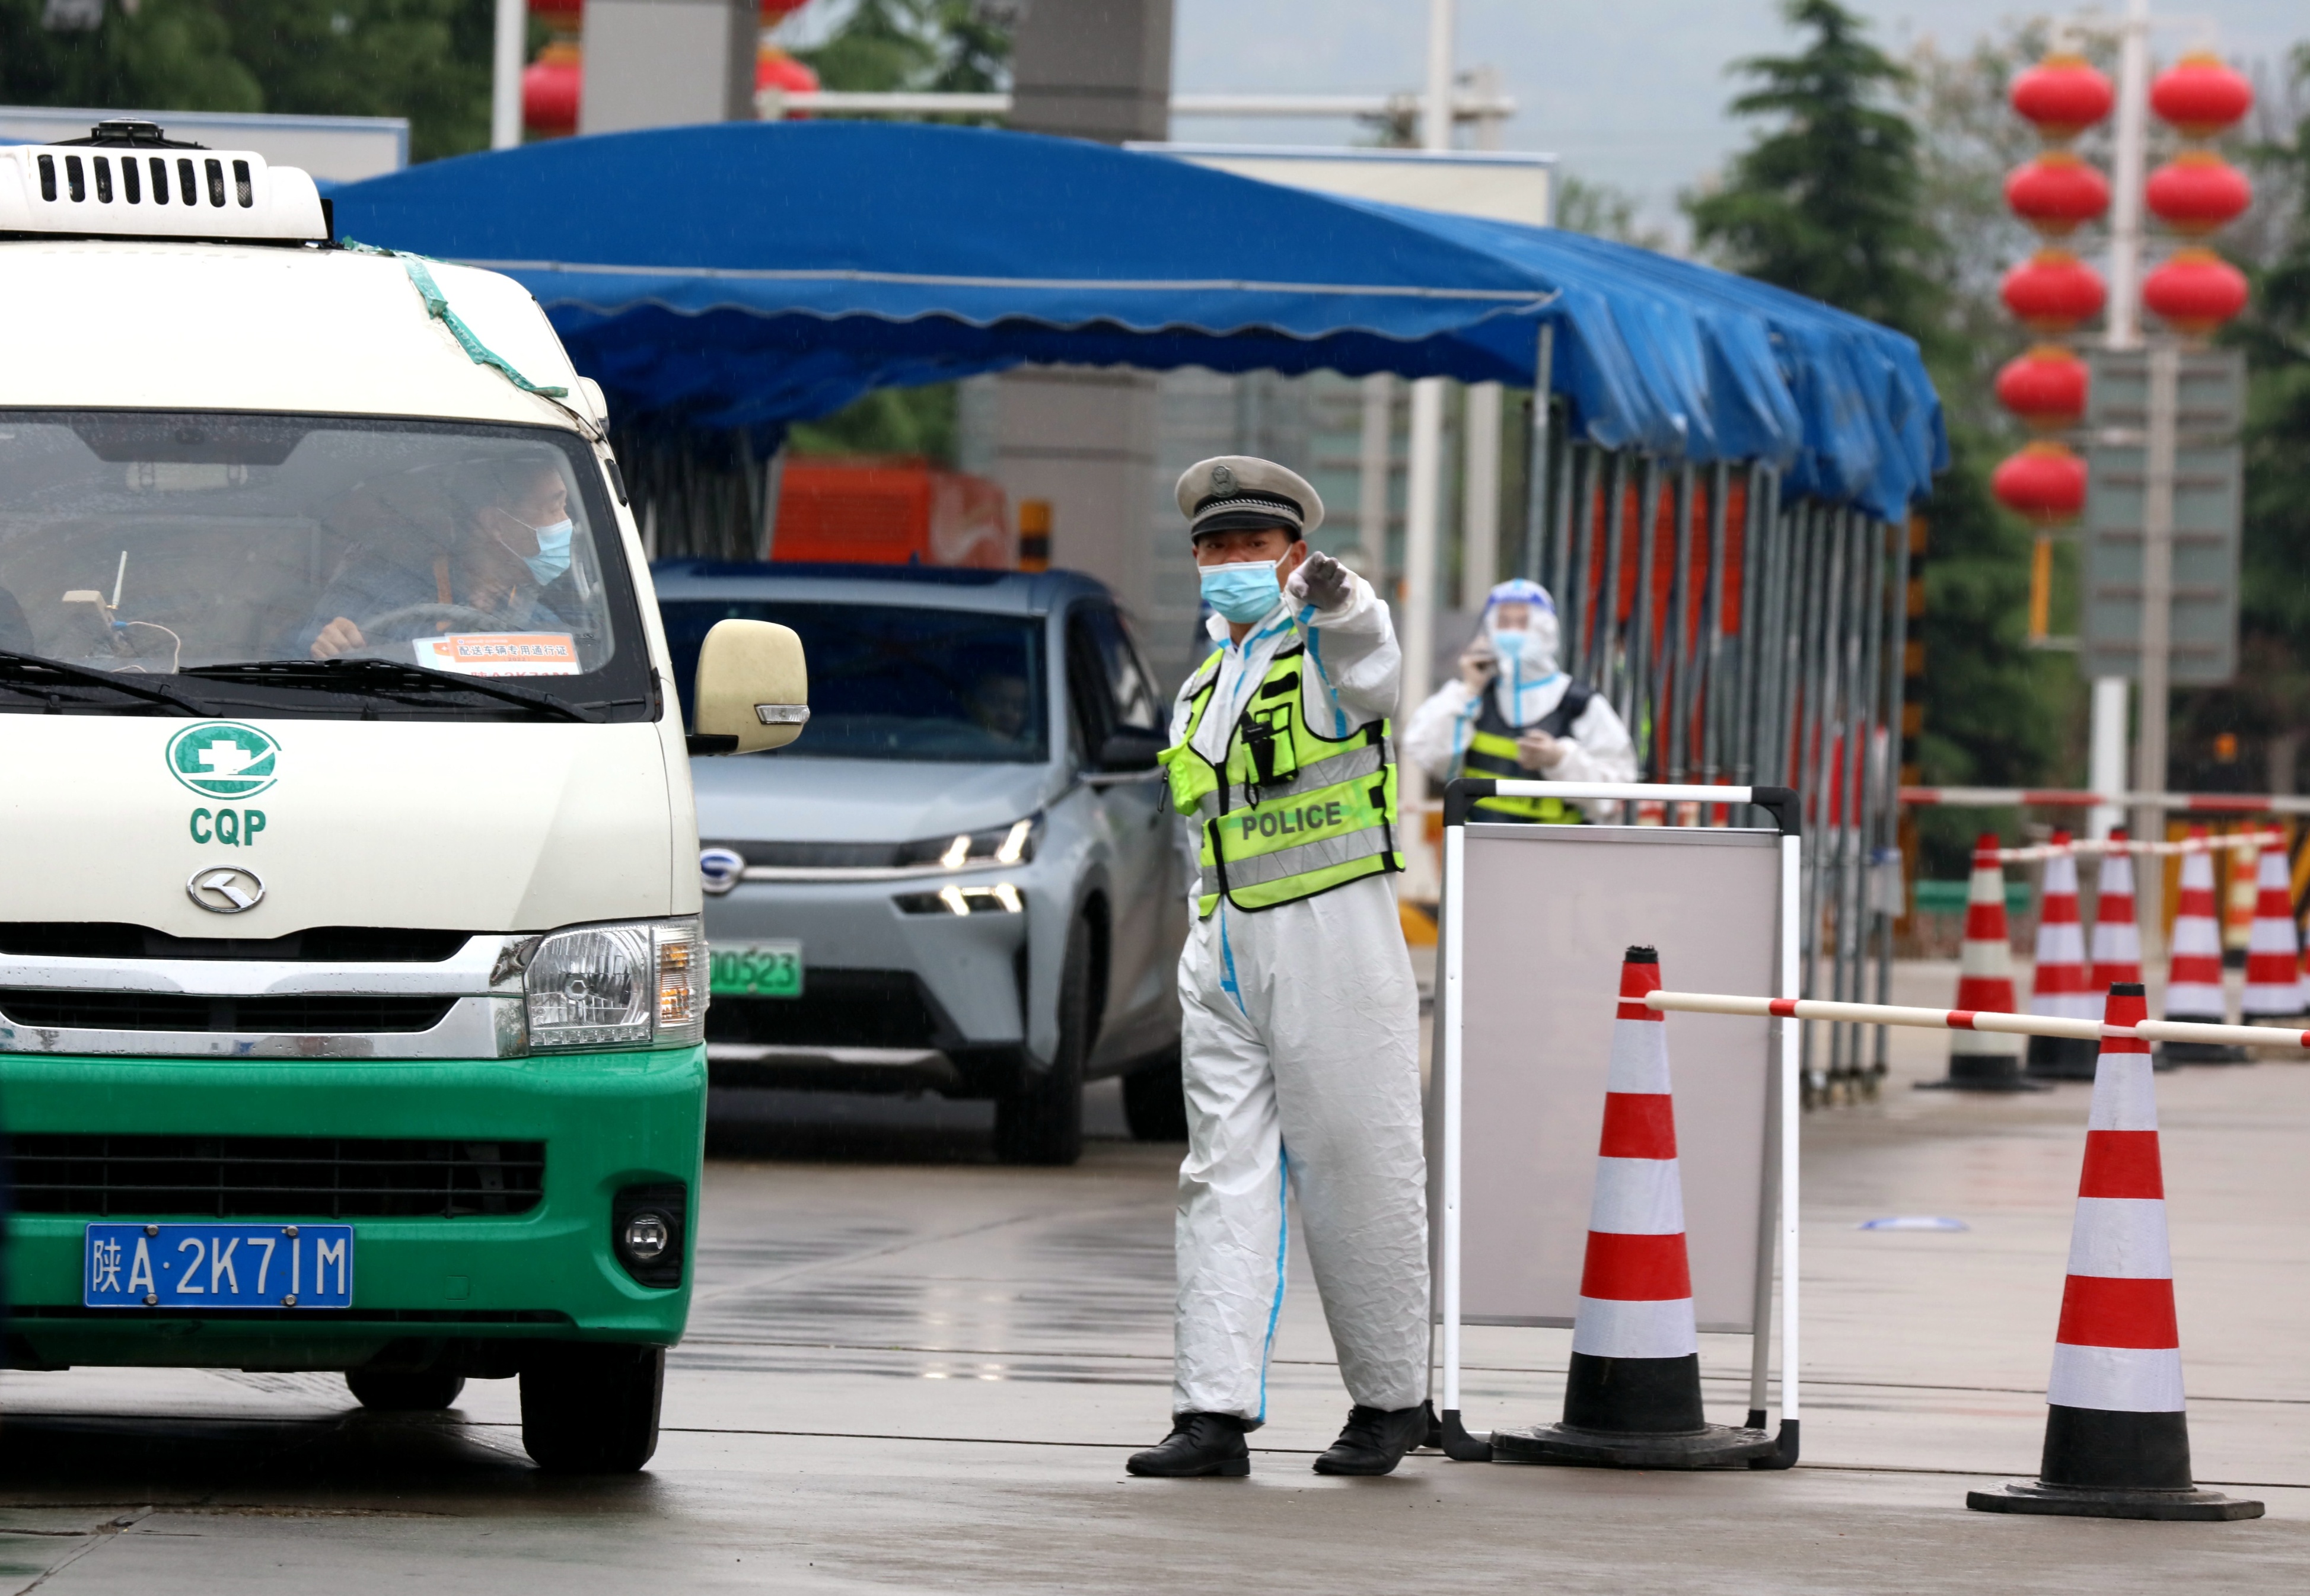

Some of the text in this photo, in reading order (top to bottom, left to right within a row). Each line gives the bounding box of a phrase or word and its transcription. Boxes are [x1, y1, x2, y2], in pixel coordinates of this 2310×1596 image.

[458, 645, 568, 656] 配送车辆专用通行证
[190, 807, 266, 848] CQP
[1242, 801, 1342, 840] POLICE
